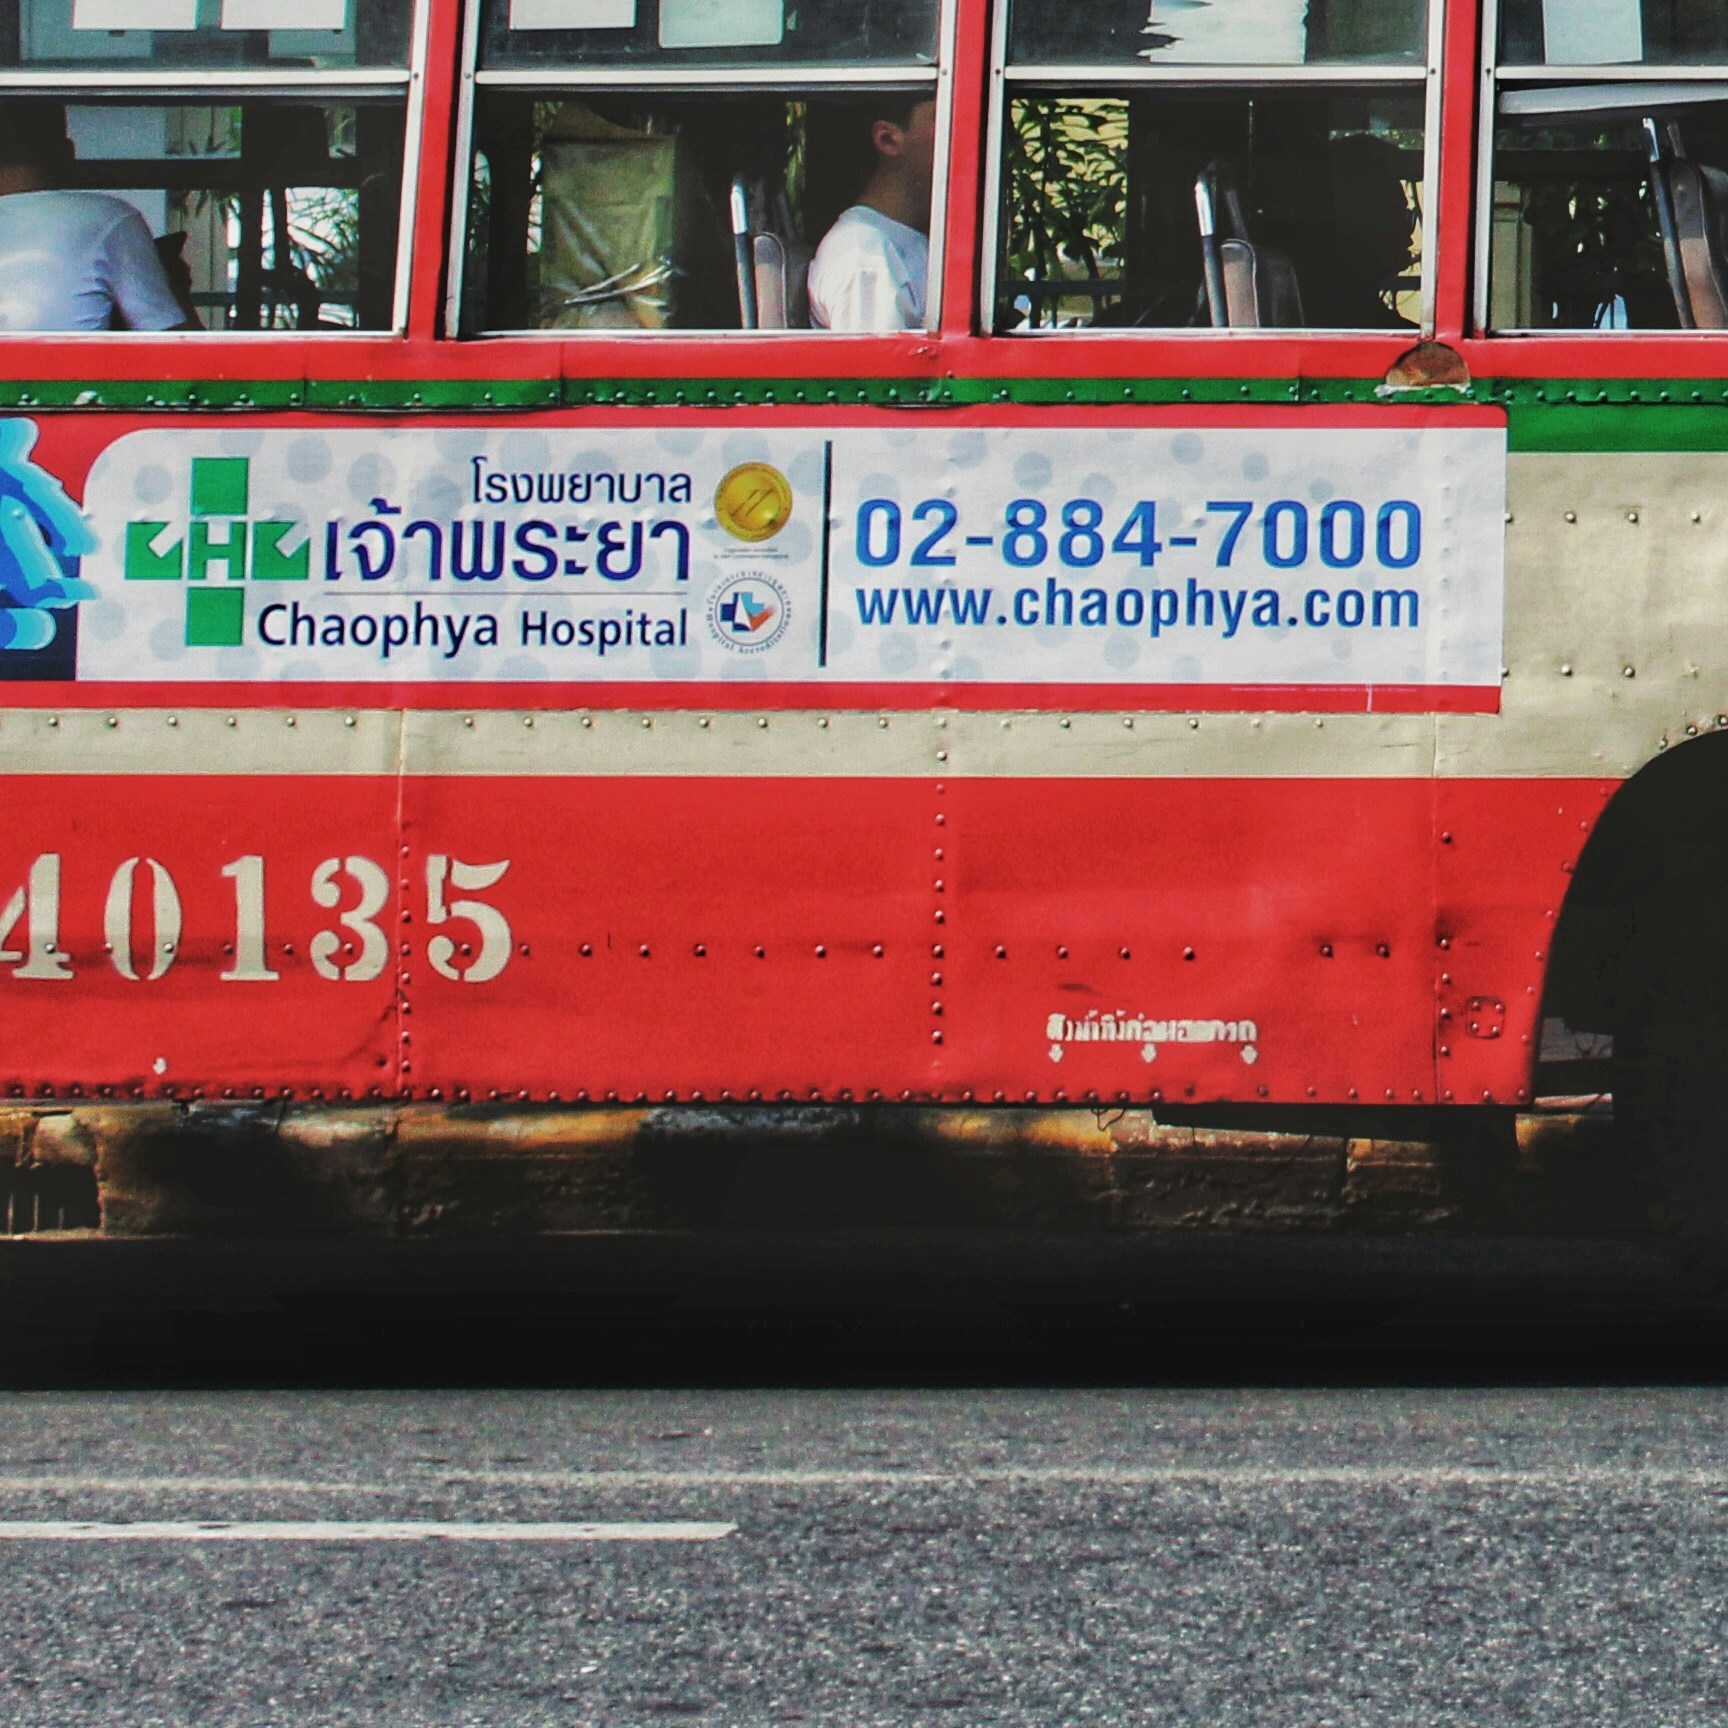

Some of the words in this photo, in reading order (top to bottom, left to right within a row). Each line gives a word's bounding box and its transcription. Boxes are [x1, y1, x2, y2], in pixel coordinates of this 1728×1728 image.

[471, 457, 692, 504] โรงพยาบาล
[324, 497, 692, 581] เจ้าพระยา
[855, 499, 1422, 569] 02-884-7000
[258, 603, 499, 659] Chaophya
[520, 608, 688, 655] Hospital
[855, 578, 1420, 639] www.chaophya.com
[0, 852, 513, 982] 40135
